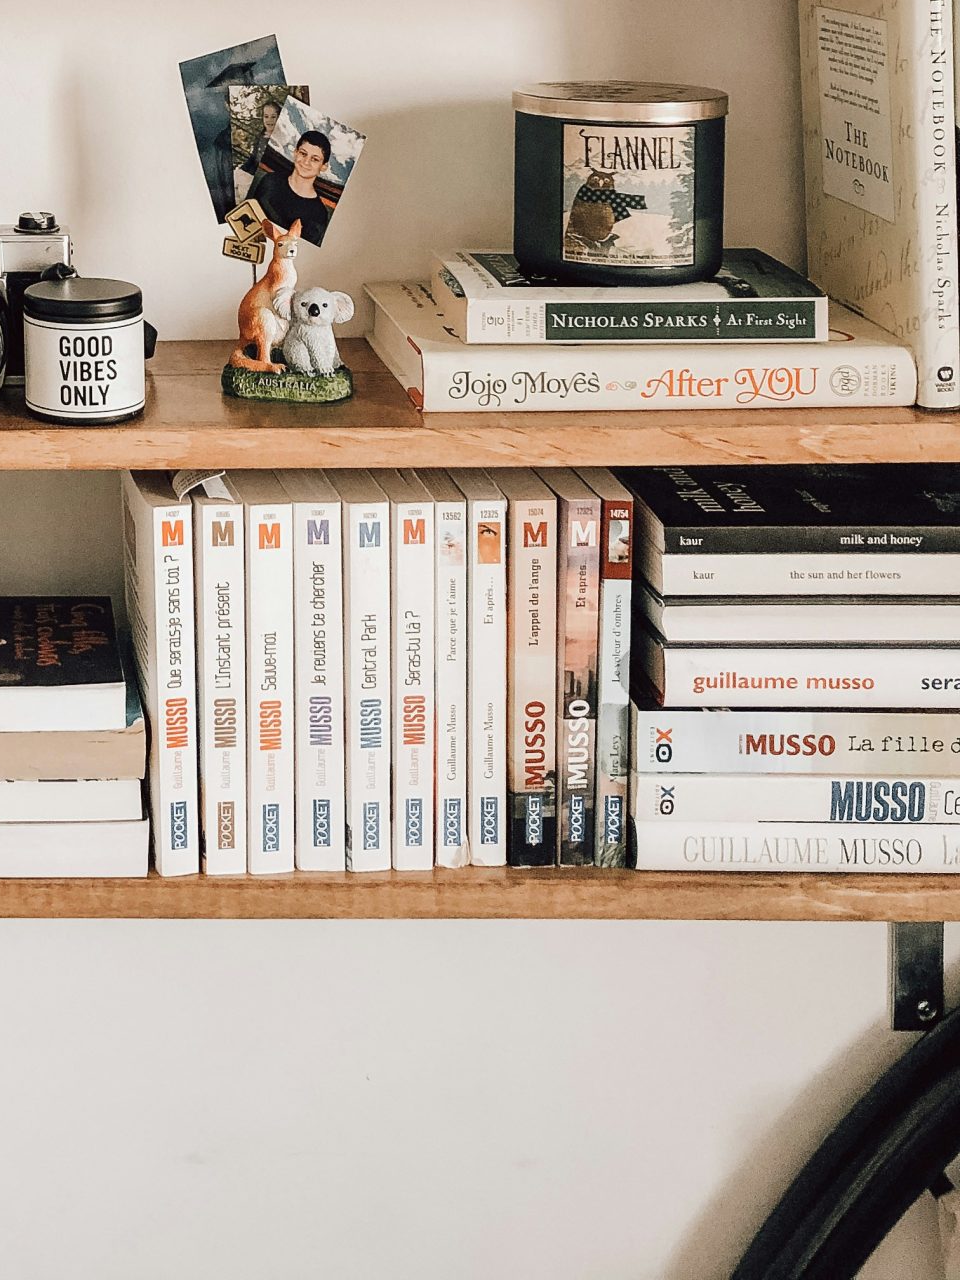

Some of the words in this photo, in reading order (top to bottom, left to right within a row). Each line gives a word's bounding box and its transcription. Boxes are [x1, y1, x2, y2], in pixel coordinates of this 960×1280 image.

[930, 49, 947, 172] NOTEBOOK
[579, 129, 681, 170] FLANNEL
[843, 121, 869, 148] THE
[824, 139, 889, 183] NOTEBOOK
[934, 204, 950, 271] Nicholas
[551, 312, 639, 328] NICHOLAS
[643, 312, 707, 329] SPARKS
[745, 314, 772, 326] First
[775, 314, 807, 330] Sight
[932, 278, 951, 330] Sparks
[59, 336, 113, 358] GOOD
[60, 360, 117, 382] VIBES
[257, 377, 317, 391] AUSTRALIA
[447, 370, 507, 406] Jojo
[640, 369, 729, 400] After
[733, 367, 819, 403] YOU
[60, 385, 110, 406] ONLY
[679, 535, 704, 546] kaur
[839, 534, 866, 545] milk
[889, 534, 924, 546] honey
[311, 561, 325, 609] chercher
[692, 570, 716, 580] kaur
[864, 570, 902, 579] flowers
[167, 588, 180, 615] sans
[215, 582, 232, 628] présent
[167, 617, 182, 666] serais-je
[361, 614, 376, 640] Park
[261, 631, 277, 690] Sauve-moi
[311, 630, 326, 671] reviens
[362, 647, 377, 689] Central
[405, 637, 421, 686] Seras-tu
[693, 672, 798, 693] guillaume
[806, 675, 875, 690] musso
[166, 698, 189, 748] MUSSO
[214, 698, 237, 748] MUSSO
[309, 696, 332, 746] MUSSO
[447, 703, 456, 734] Musso
[447, 735, 457, 782] Guillaume
[525, 701, 545, 786] MUSSO
[610, 733, 622, 757] Levy
[746, 734, 835, 756] MUSSO
[881, 736, 943, 752] fille
[609, 759, 620, 784] Marc
[480, 797, 497, 844] POCKET
[830, 781, 925, 821] MUSSO
[170, 801, 187, 850] POCKET
[313, 799, 330, 847] POCKET
[683, 837, 828, 863] GUILLAUME
[837, 837, 923, 864] MUSSO
